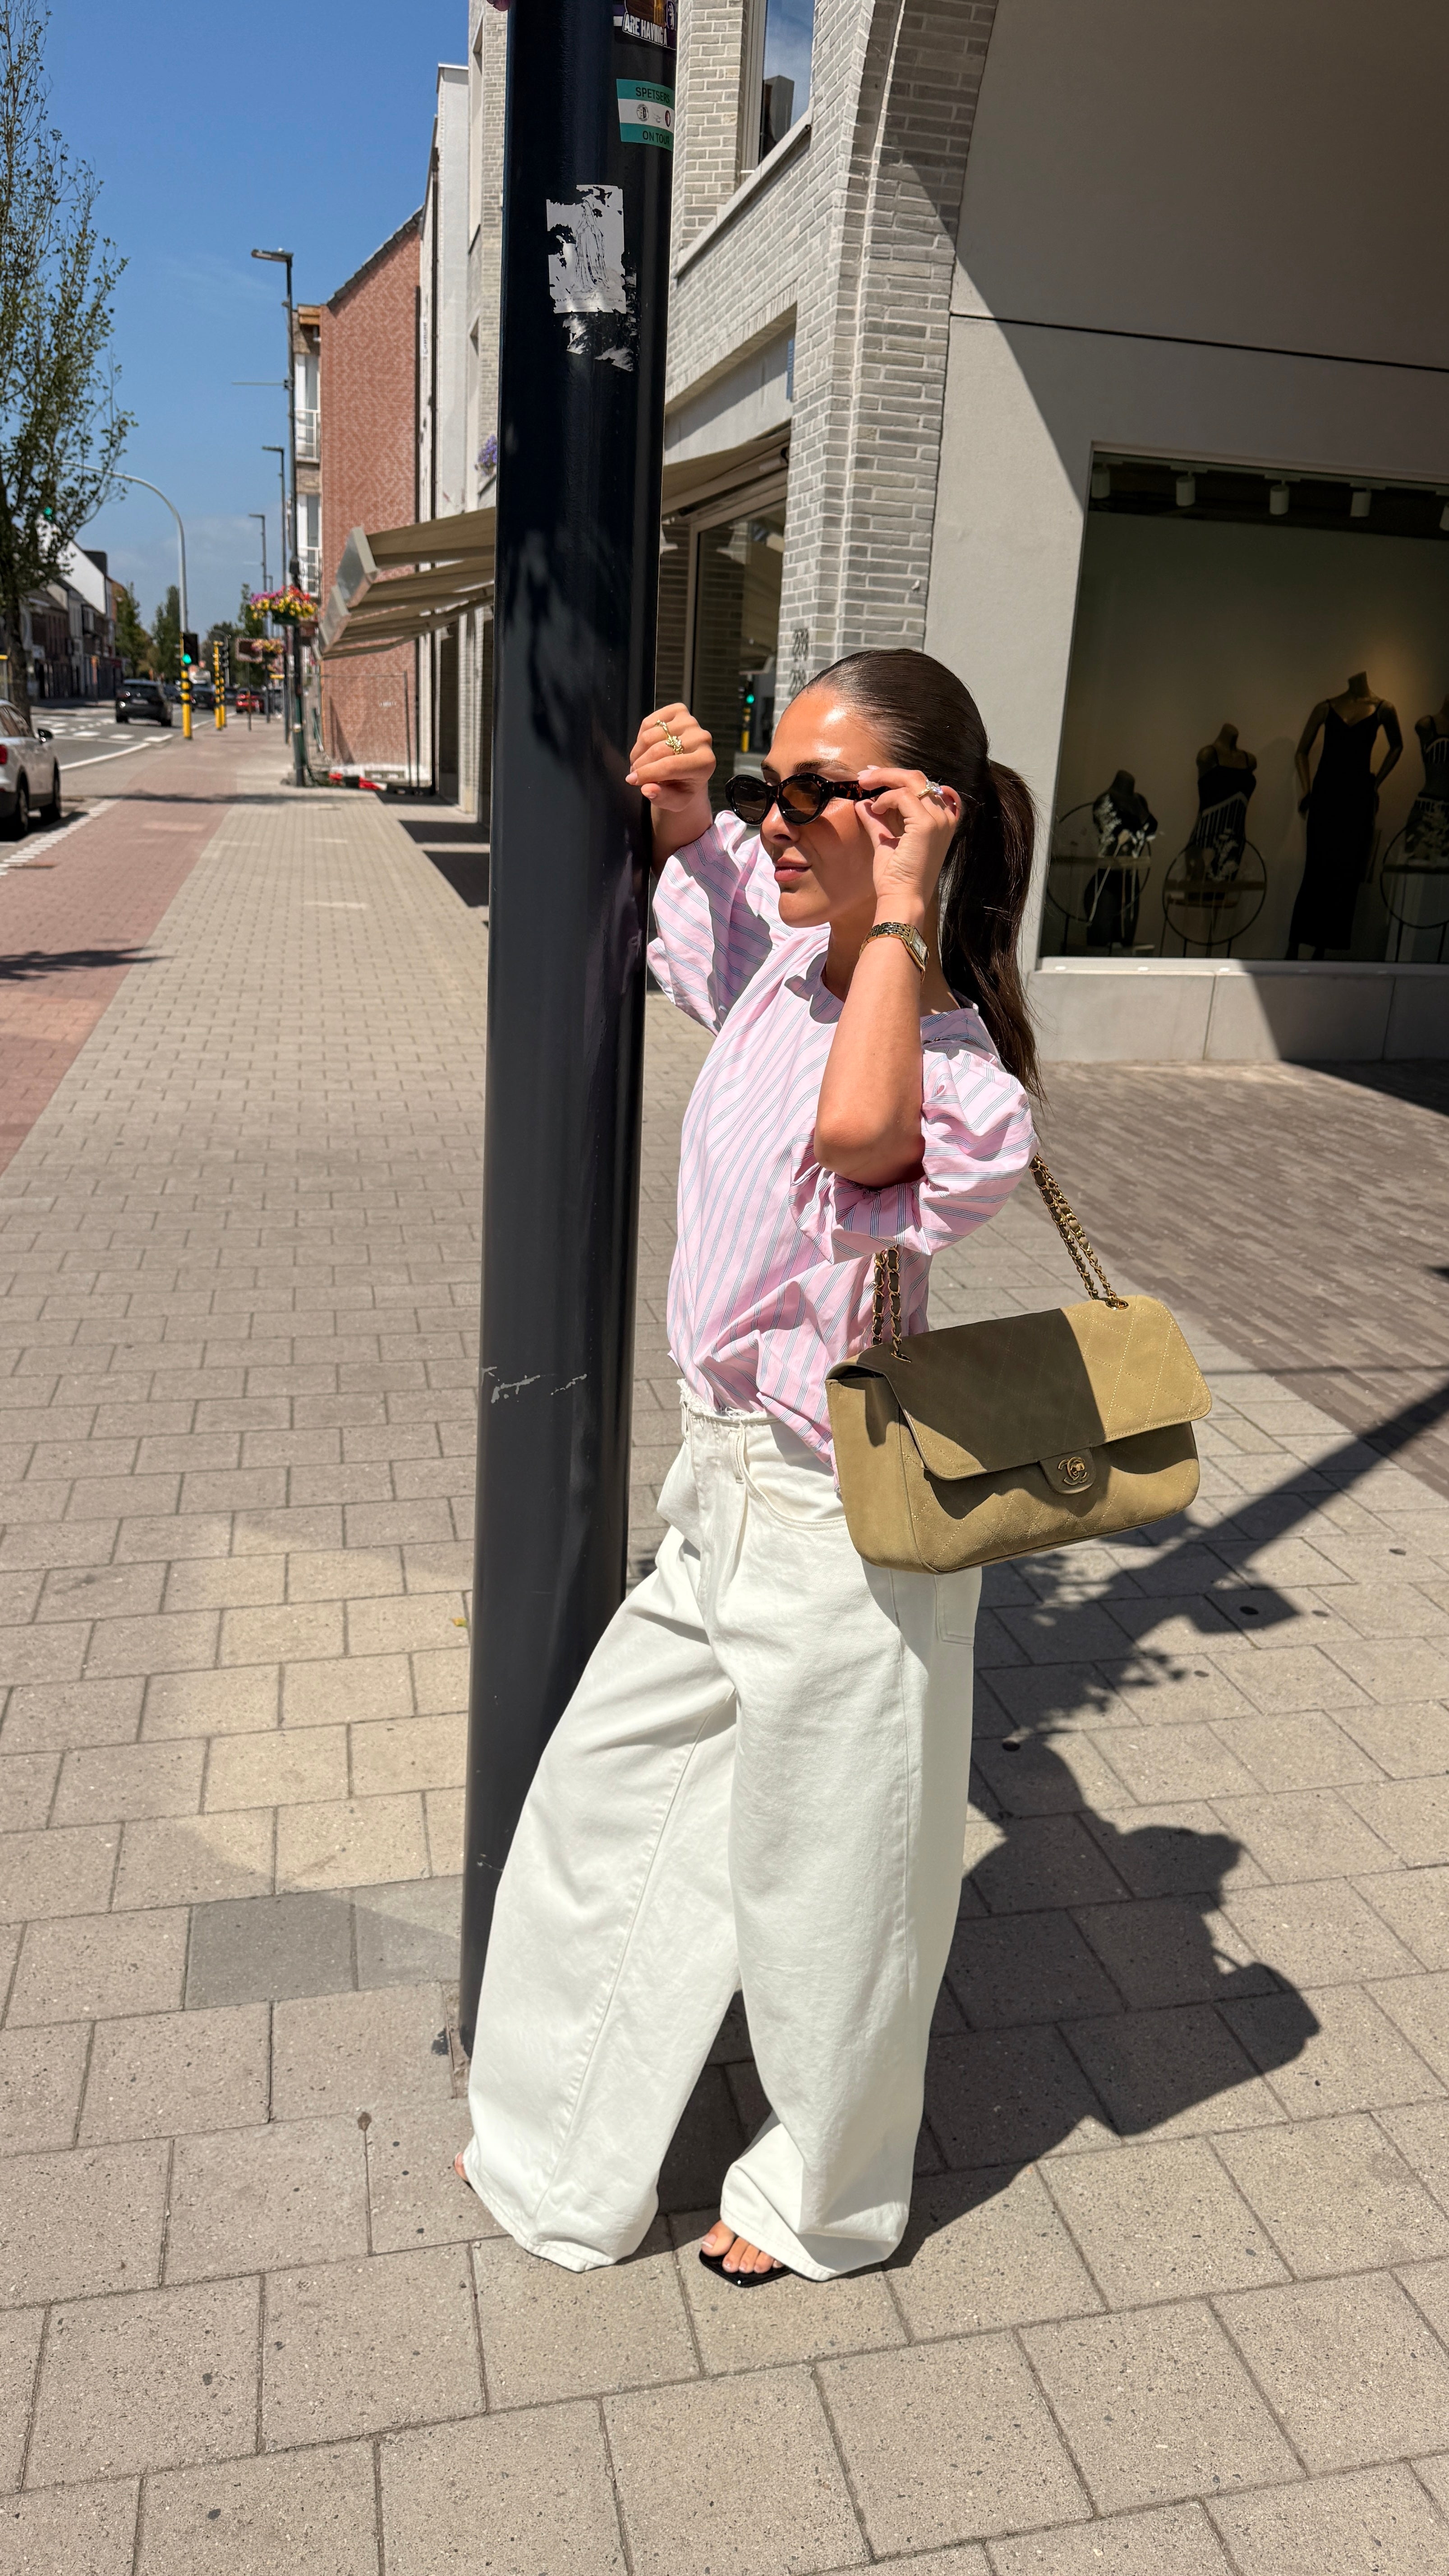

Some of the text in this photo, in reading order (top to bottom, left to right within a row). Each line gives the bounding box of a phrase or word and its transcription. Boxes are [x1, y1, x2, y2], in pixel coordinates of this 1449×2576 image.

[624, 14, 640, 36] ARE
[641, 19, 663, 44] HAVING
[636, 87, 670, 103] SPETSERS
[643, 130, 670, 146] ON TOUR
